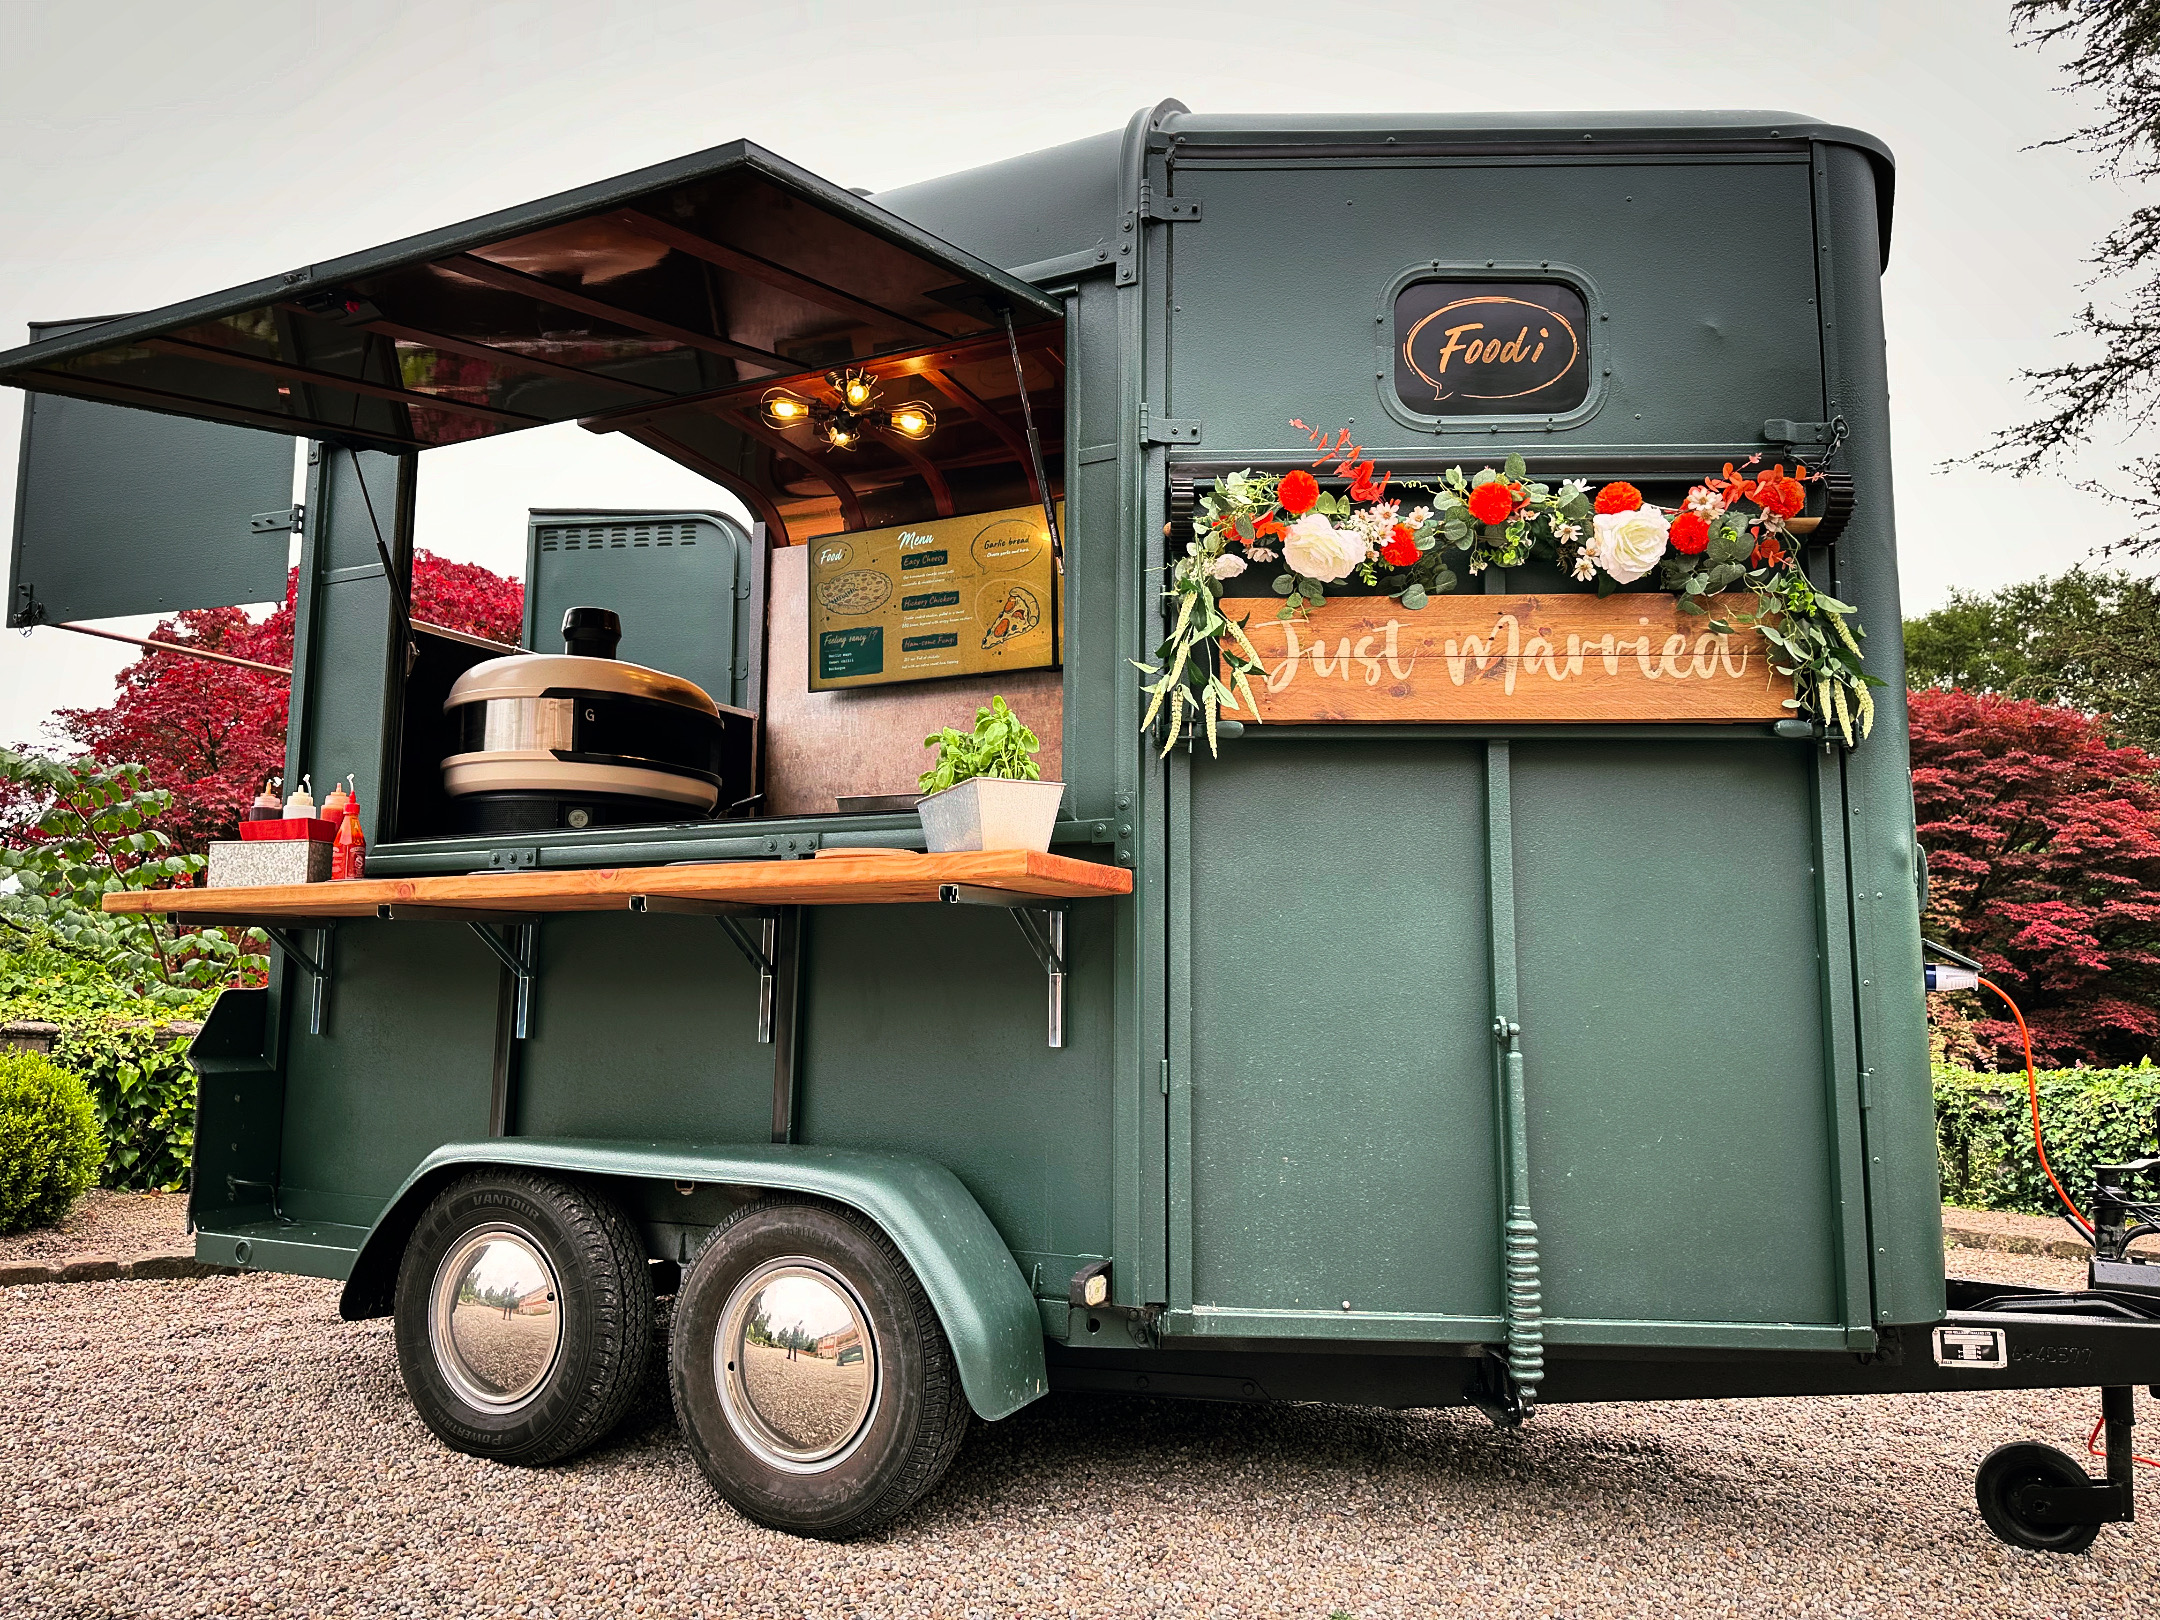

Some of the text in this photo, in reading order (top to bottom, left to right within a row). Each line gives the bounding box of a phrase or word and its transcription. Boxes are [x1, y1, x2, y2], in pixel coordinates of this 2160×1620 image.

[1438, 322, 1549, 374] Foodi
[897, 531, 935, 551] Menu
[984, 535, 1031, 550] Garlic bread
[903, 557, 921, 567] Easy
[823, 633, 847, 649] Feeling
[1254, 613, 1749, 697] Just Married
[585, 708, 595, 722] G
[472, 1194, 541, 1221] VANTOUR
